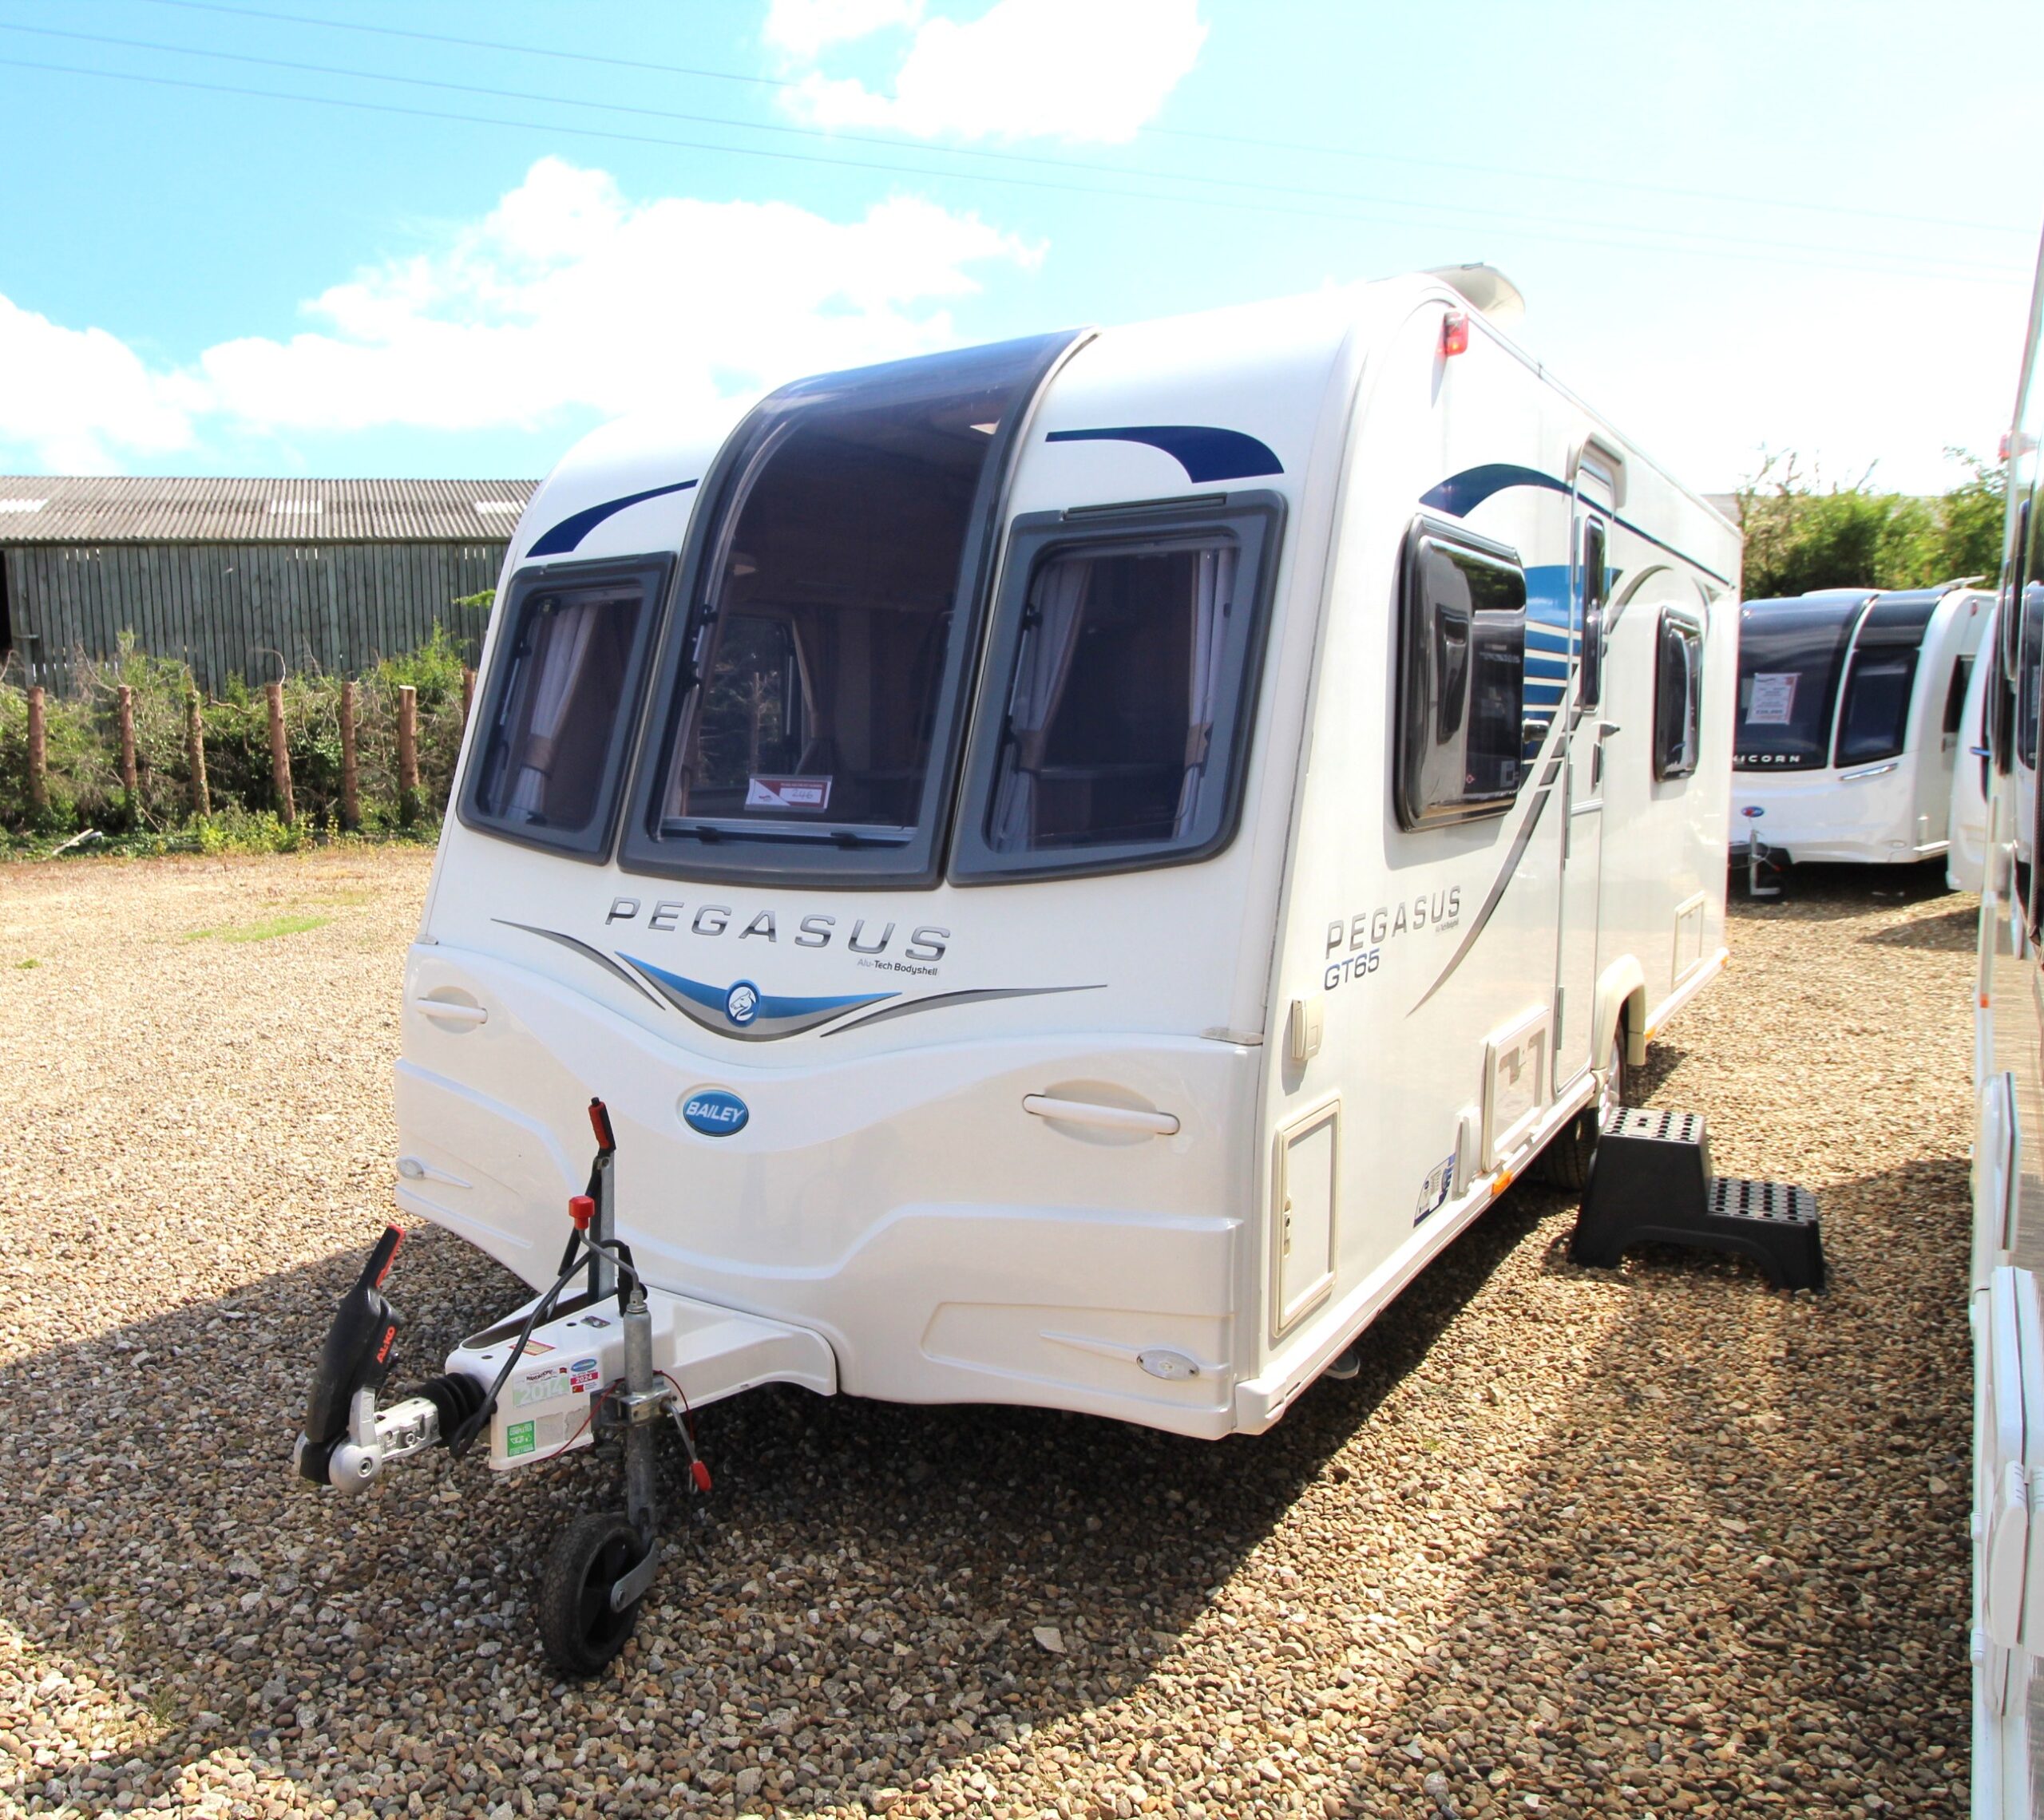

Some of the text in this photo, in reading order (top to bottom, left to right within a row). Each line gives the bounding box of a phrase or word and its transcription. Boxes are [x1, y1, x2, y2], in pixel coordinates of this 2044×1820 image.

[604, 896, 951, 962] PEGASUS
[1325, 885, 1461, 959] PEGASUS
[893, 963, 938, 976] Bodyshell
[1324, 948, 1380, 991] GT65
[686, 1101, 745, 1122] BAILEY
[576, 1374, 593, 1384] 2024
